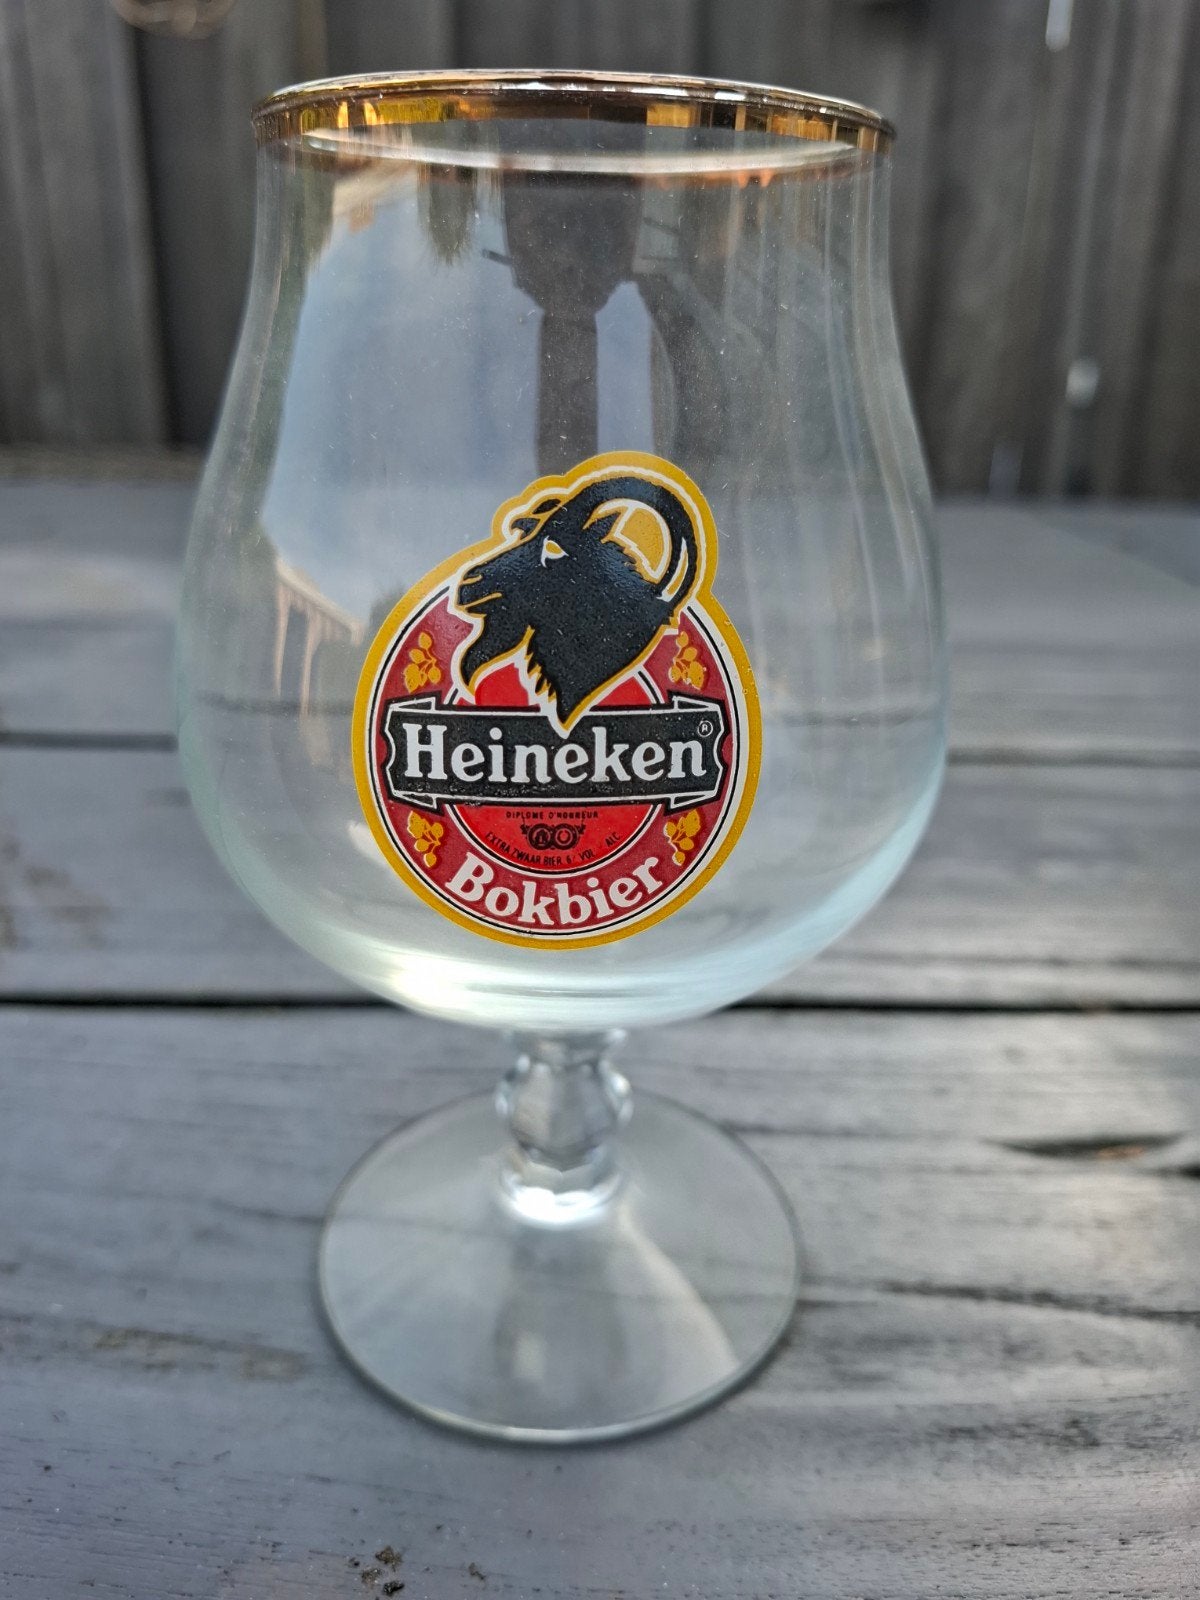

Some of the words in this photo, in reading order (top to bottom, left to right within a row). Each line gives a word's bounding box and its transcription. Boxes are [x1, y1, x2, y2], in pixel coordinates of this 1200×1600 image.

[402, 723, 706, 784] Heineken
[485, 831, 510, 853] EXTRA
[511, 848, 541, 863] ZWAAR
[543, 856, 562, 866] BIER
[445, 852, 663, 925] Bokbier
